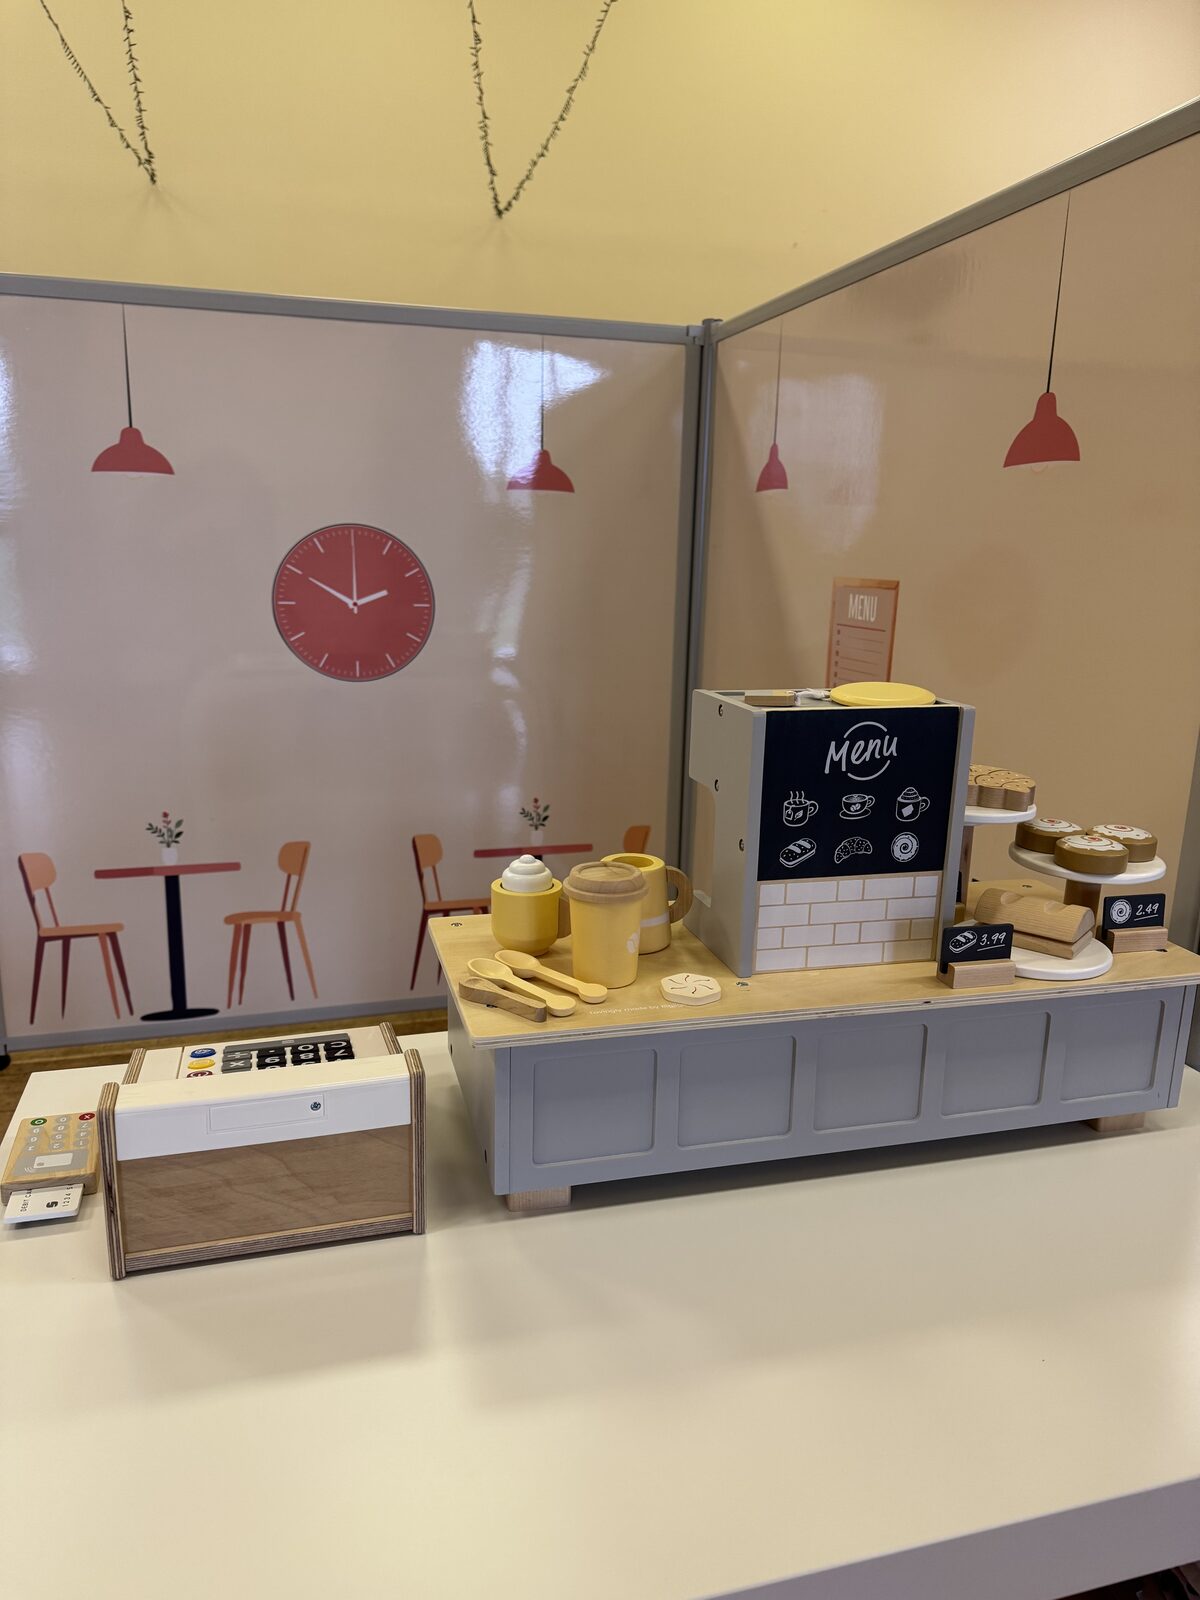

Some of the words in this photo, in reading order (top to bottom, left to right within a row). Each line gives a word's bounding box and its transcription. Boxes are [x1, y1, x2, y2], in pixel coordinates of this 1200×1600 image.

[848, 593, 878, 622] MENU
[824, 735, 898, 774] Menu
[1135, 902, 1160, 916] 2.49
[979, 932, 1007, 946] 3.99
[299, 1052, 315, 1060] 8
